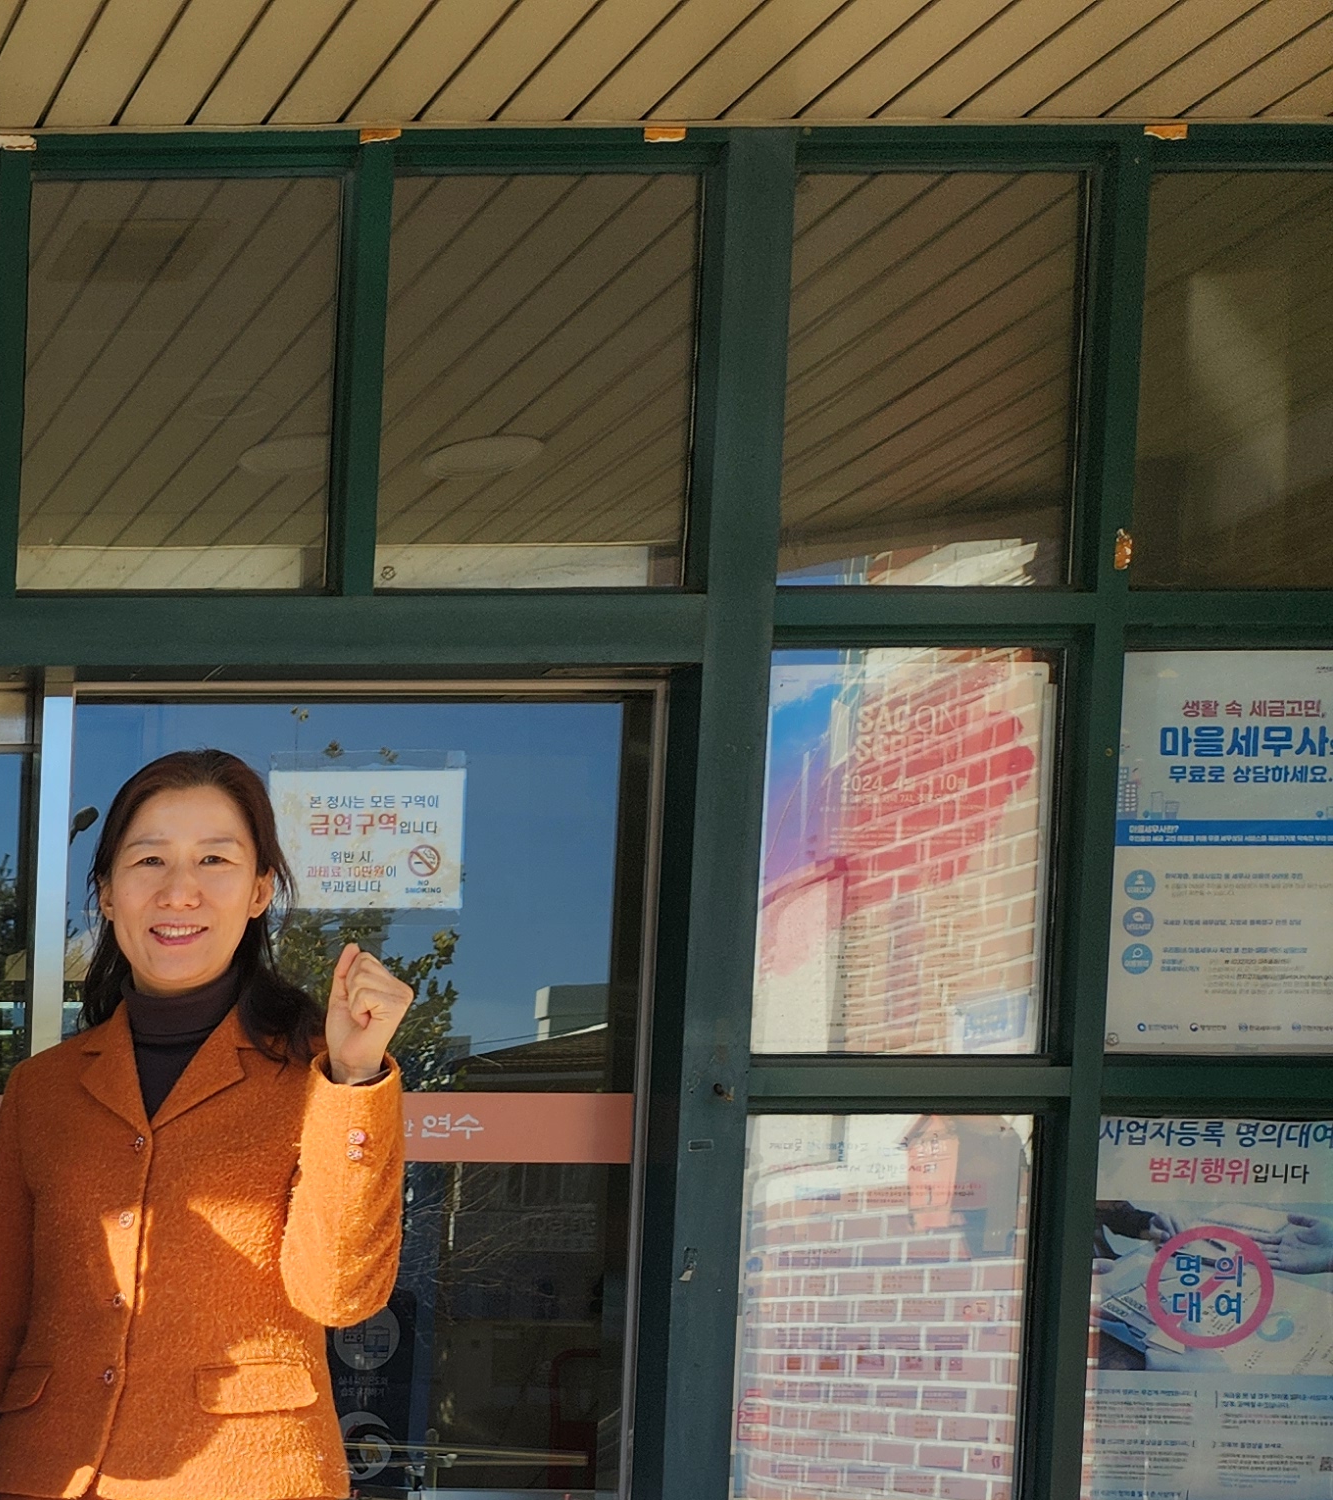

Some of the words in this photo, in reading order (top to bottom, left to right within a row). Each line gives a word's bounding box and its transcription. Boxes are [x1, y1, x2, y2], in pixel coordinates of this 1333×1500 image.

[1182, 700, 1219, 718] 생활
[1225, 700, 1242, 718] 속
[1249, 699, 1327, 719] 세금고민,
[1159, 725, 1333, 759] 마을세무사
[1168, 765, 1226, 784] 무료로
[1232, 764, 1333, 785] 상담하세요.
[369, 795, 396, 809] 모든
[400, 795, 440, 809] 구역이
[330, 850, 355, 864] 위반
[320, 879, 382, 893] 부과됩니다
[420, 1113, 485, 1140] 연수
[1099, 1119, 1225, 1149] 사업자등록
[1148, 1157, 1311, 1186] 범죄행위입니다
[1174, 1254, 1245, 1288] 명의
[1170, 1290, 1243, 1325] 대여
